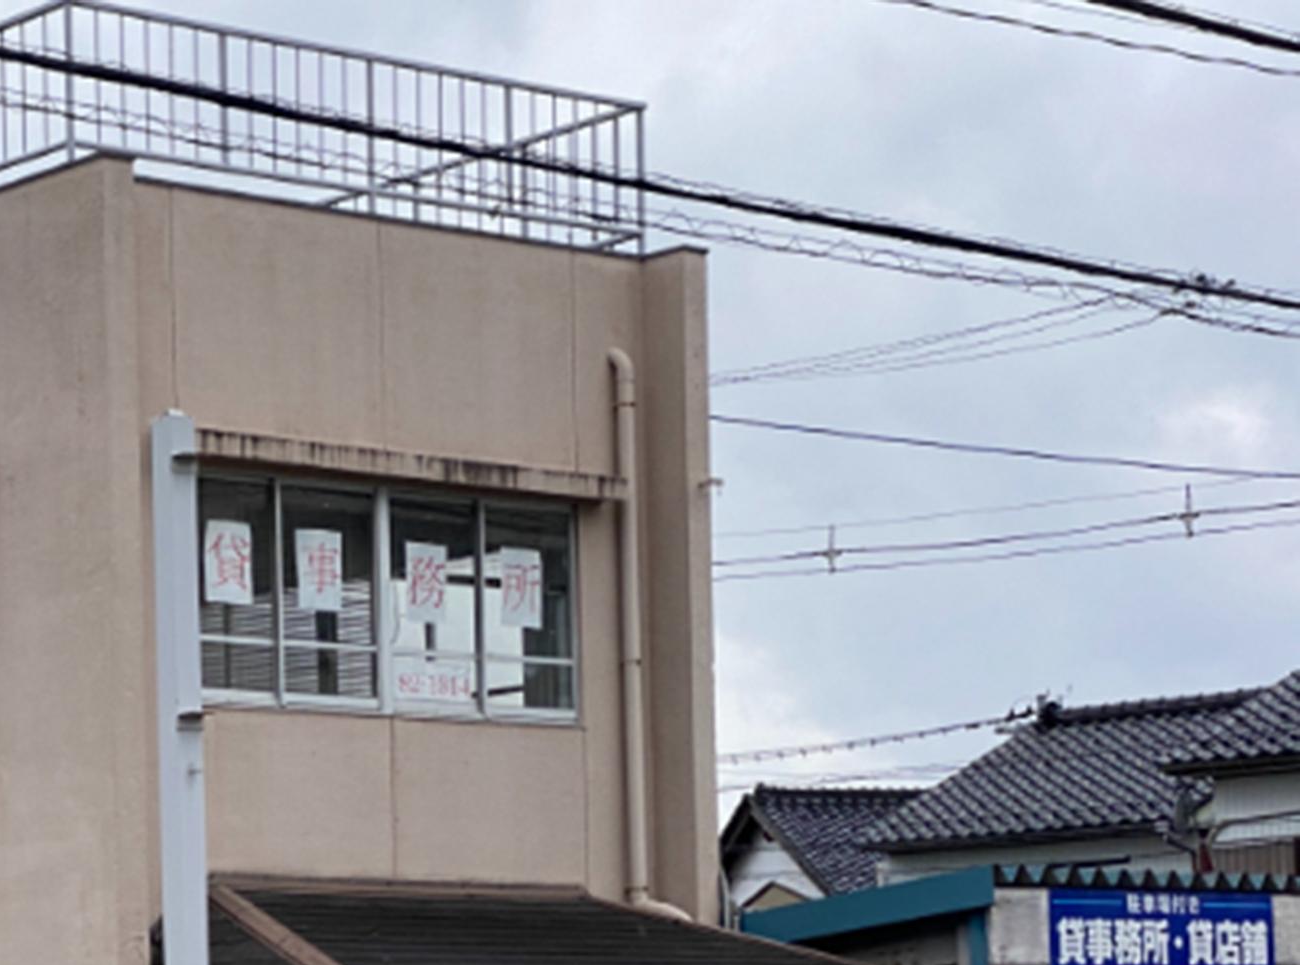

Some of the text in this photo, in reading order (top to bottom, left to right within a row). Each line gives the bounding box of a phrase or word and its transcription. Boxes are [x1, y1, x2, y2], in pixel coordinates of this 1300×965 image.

[206, 533, 540, 613] 貸 事 務 所
[1057, 917, 1268, 965] 貸事務所・貸店舗
